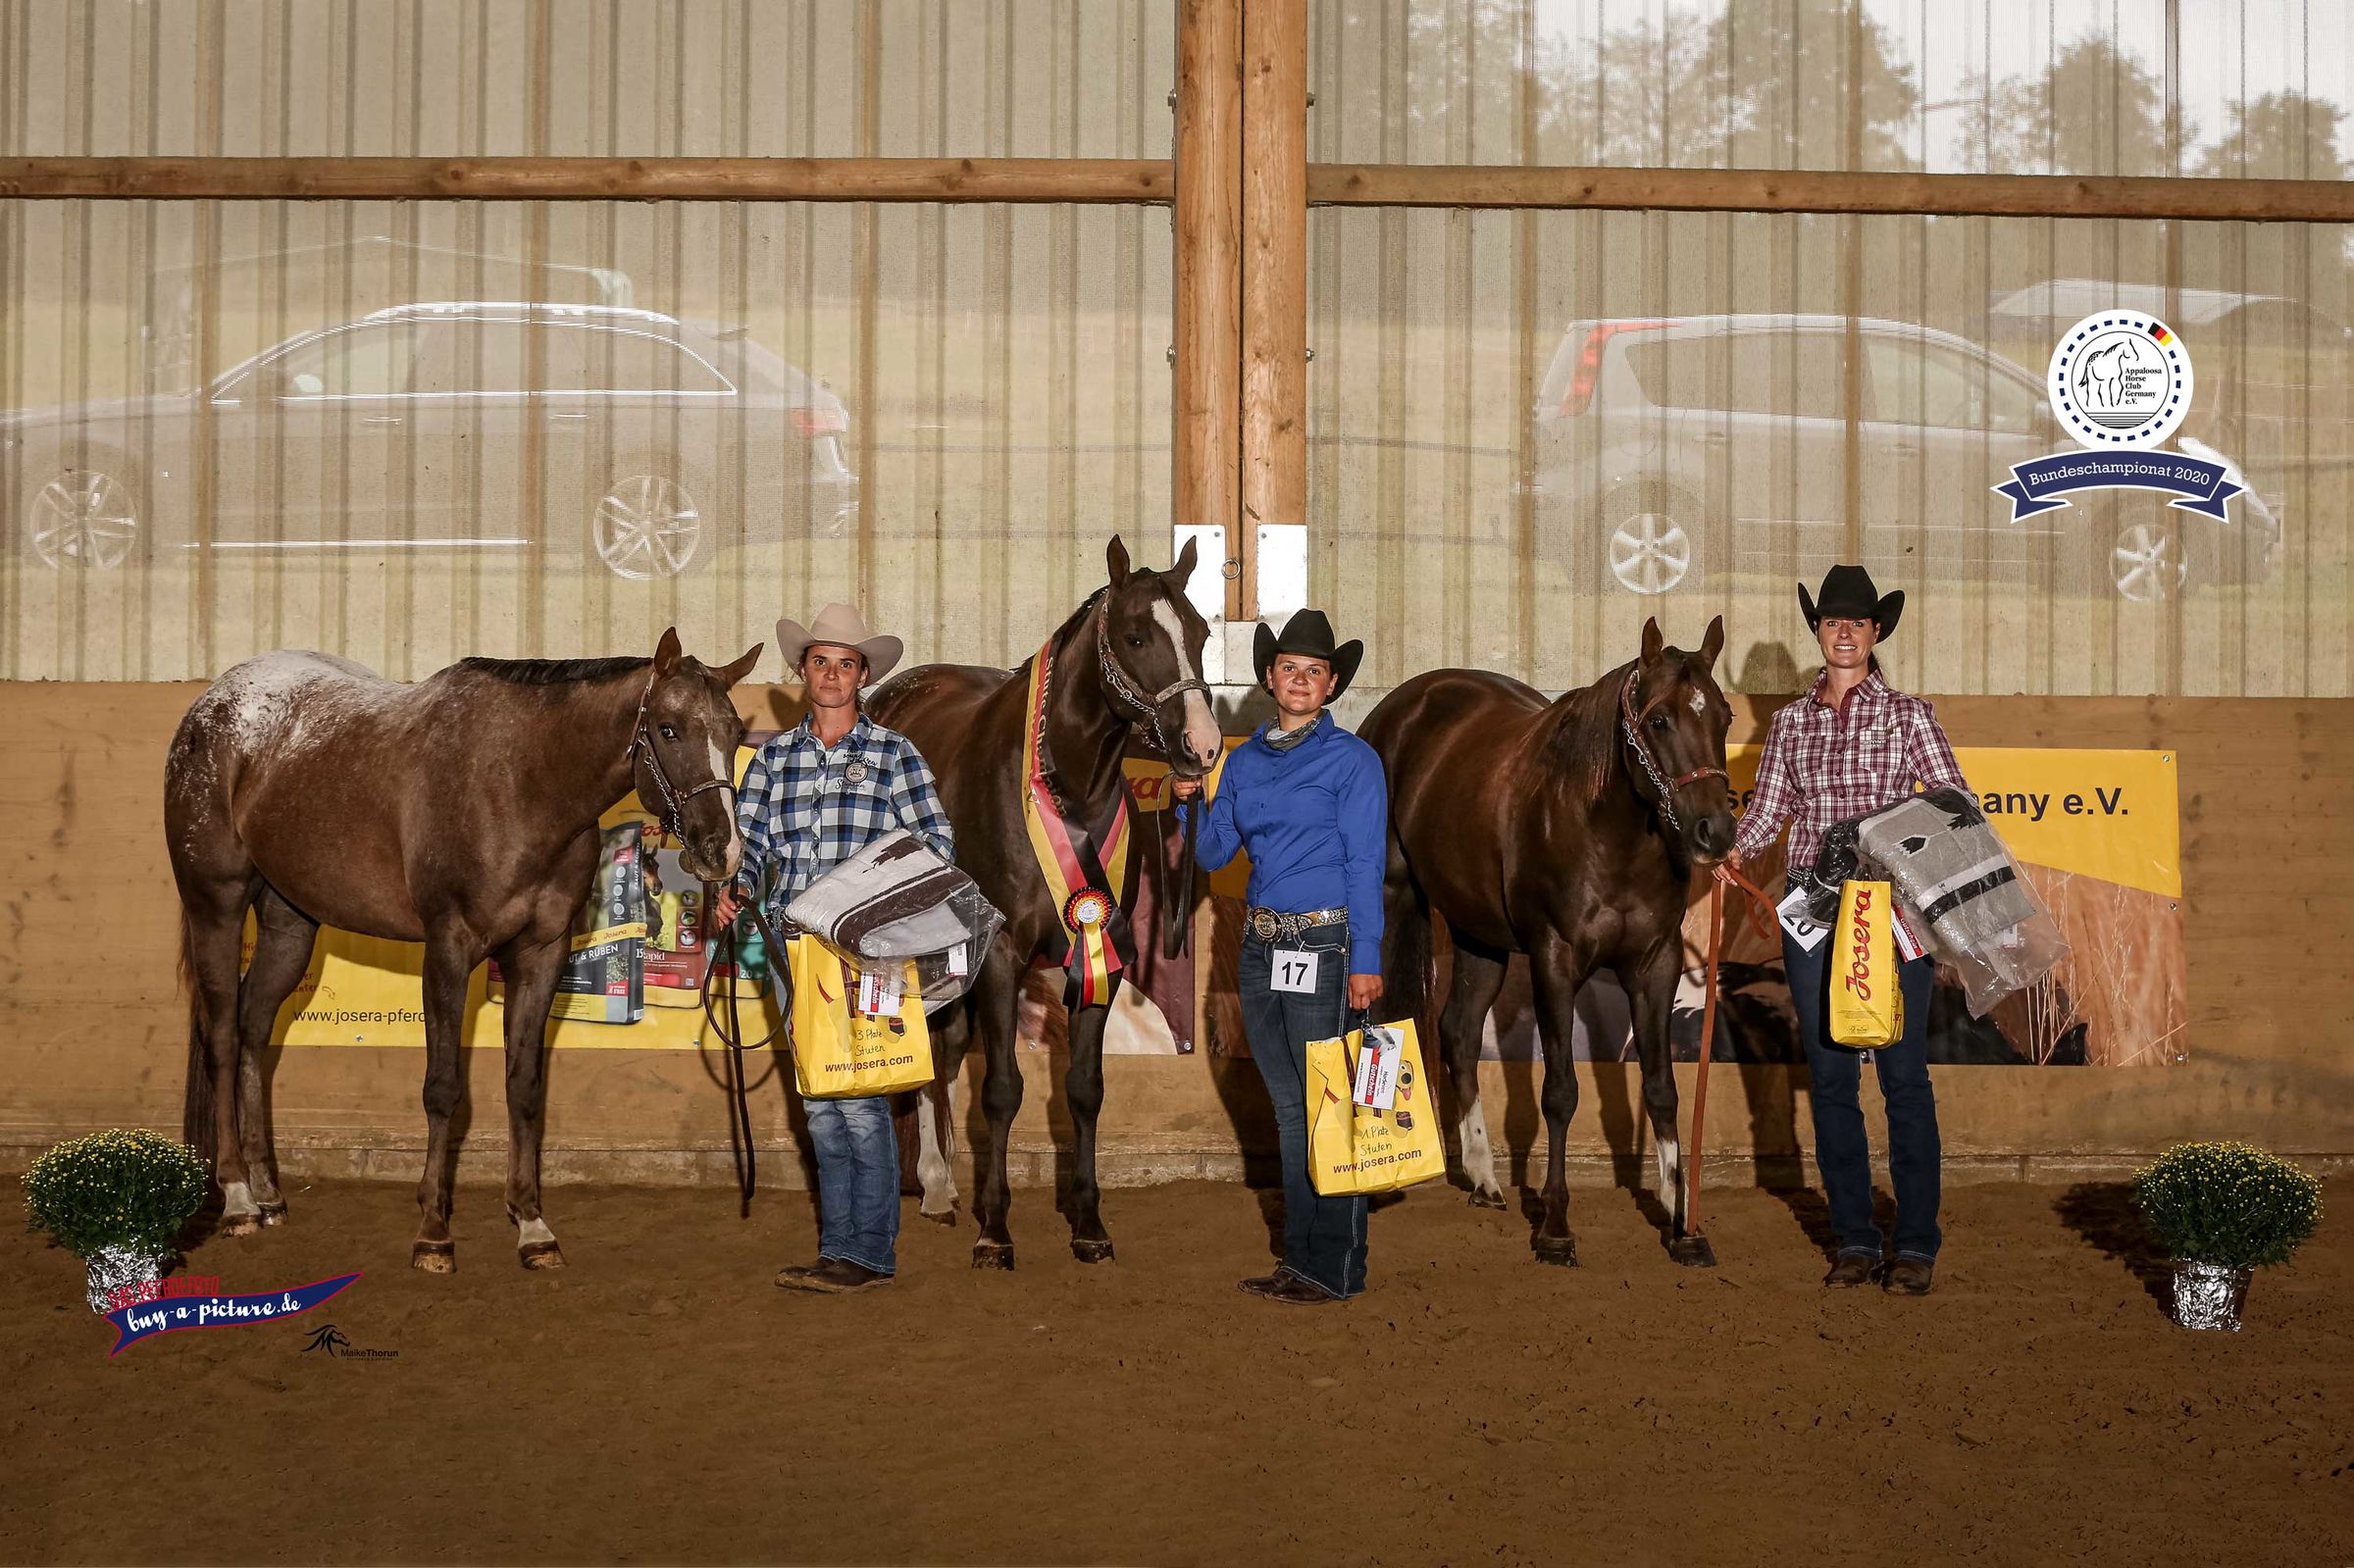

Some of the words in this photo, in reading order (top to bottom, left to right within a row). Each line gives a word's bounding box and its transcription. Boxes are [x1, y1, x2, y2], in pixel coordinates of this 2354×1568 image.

[1972, 792, 2050, 822] any
[2063, 787, 2129, 816] e.V.
[581, 951, 588, 960] &
[588, 943, 619, 959] RÜBEN
[1846, 889, 1872, 1002] Josera
[1281, 961, 1308, 986] 17
[825, 1054, 914, 1073] www.josera.com
[1366, 1063, 1378, 1096] Gutschein
[1333, 1149, 1422, 1174] www.josera.com
[1359, 1142, 1393, 1157] Stuten
